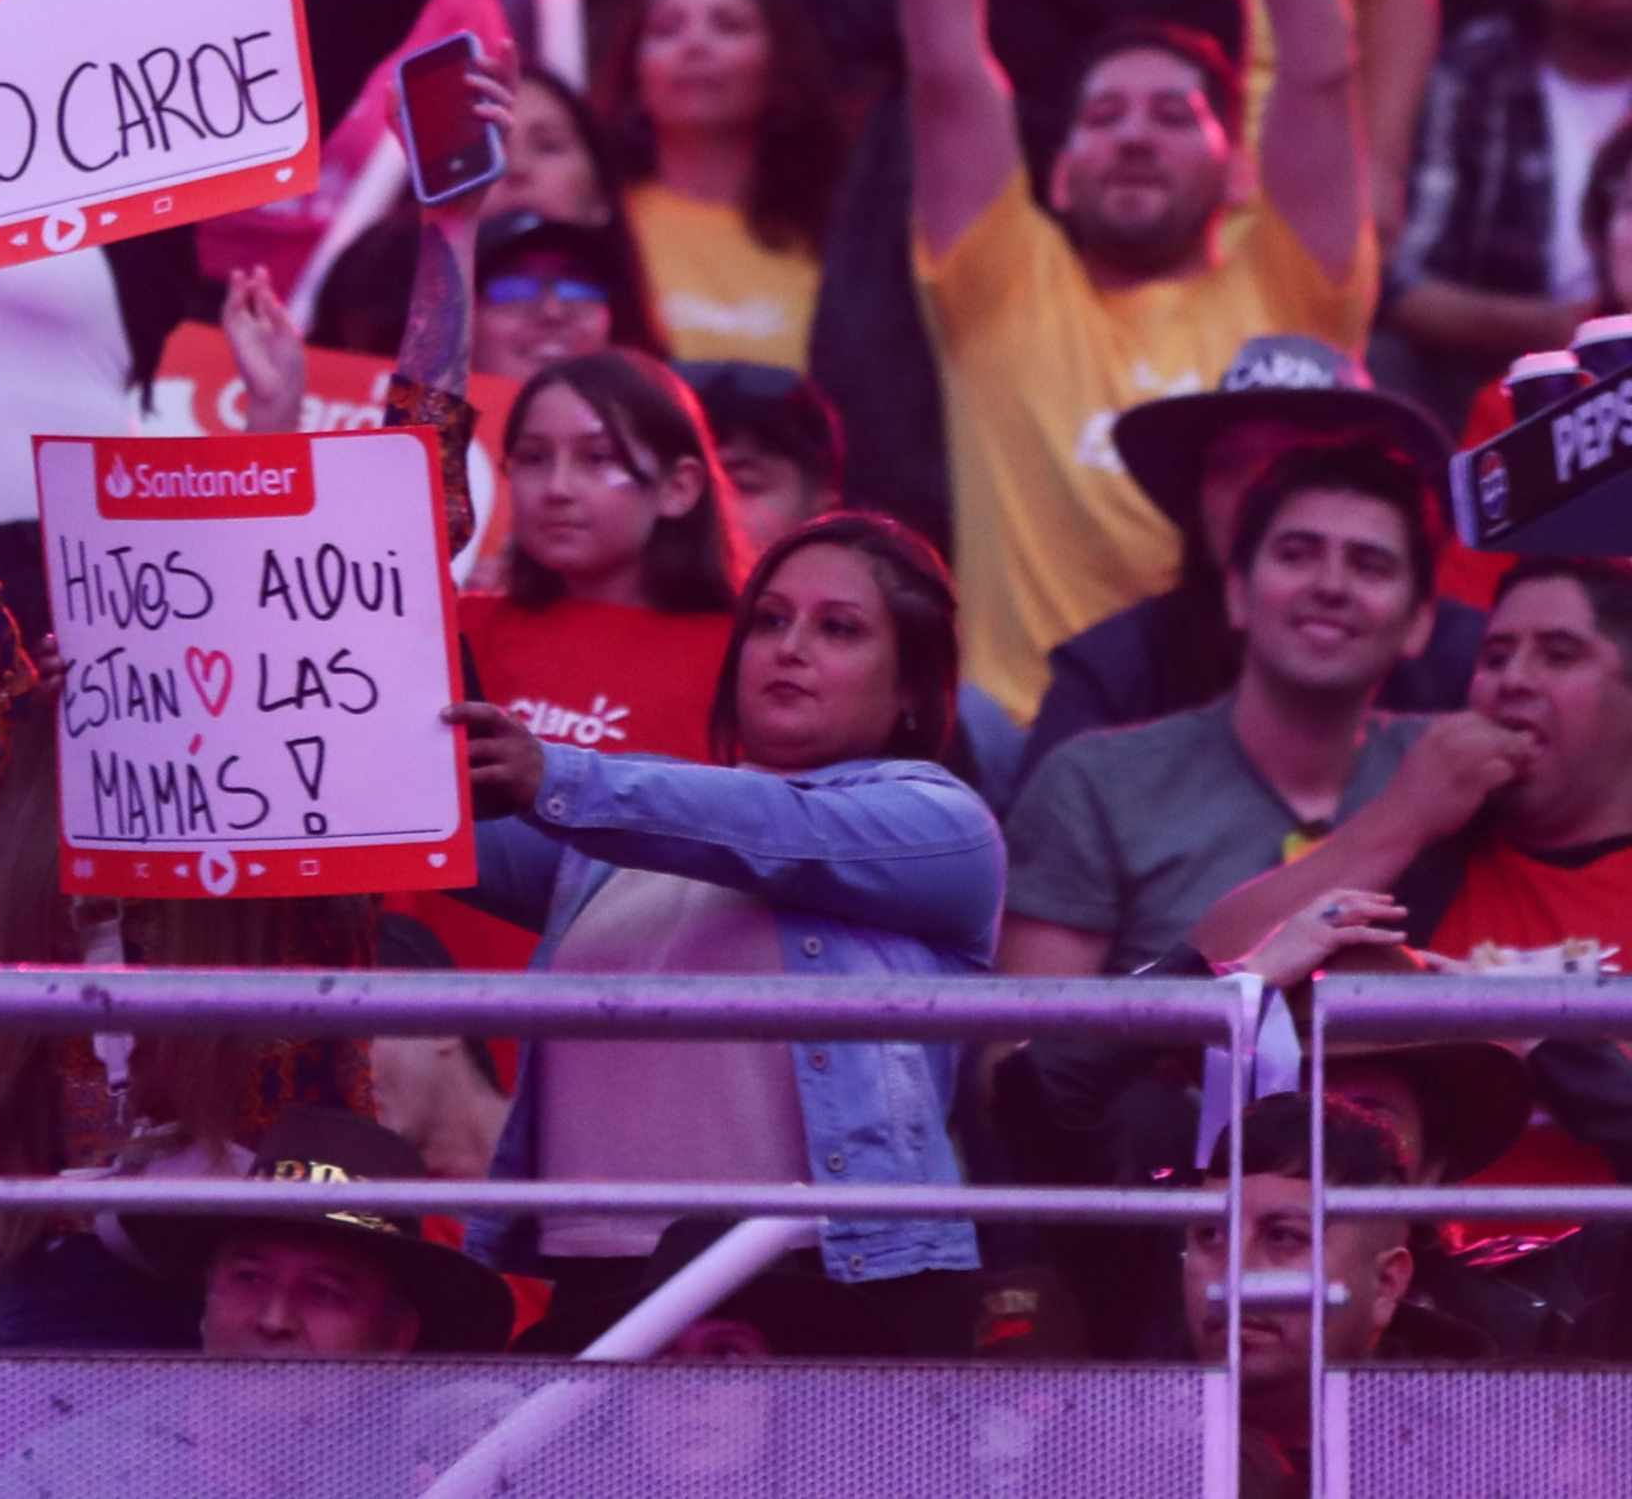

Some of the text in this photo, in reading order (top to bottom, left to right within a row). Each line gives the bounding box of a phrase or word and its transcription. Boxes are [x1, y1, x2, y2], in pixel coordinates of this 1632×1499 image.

[56, 30, 304, 173] CAROE
[134, 462, 297, 500] Santander
[257, 648, 379, 715] LAS
